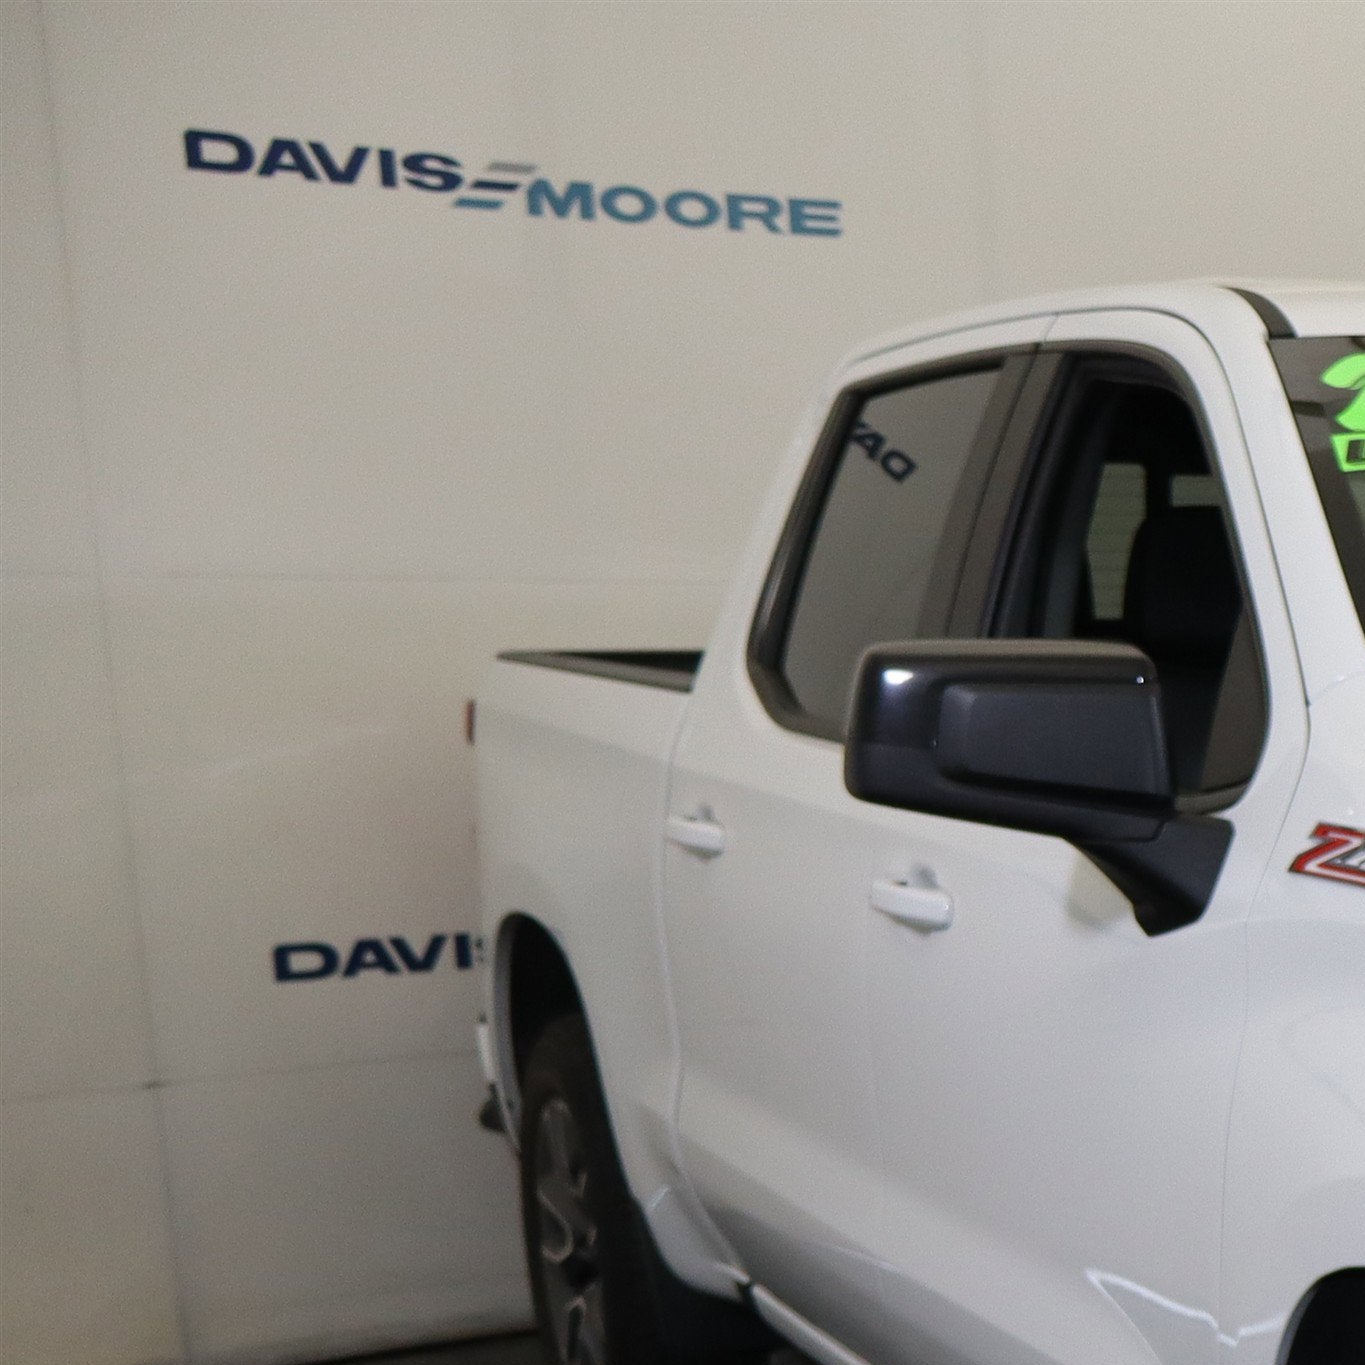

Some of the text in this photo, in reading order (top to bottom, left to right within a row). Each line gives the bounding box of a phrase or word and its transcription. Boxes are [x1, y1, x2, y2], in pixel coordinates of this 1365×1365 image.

[183, 129, 840, 236] DAVIS MOORE
[273, 933, 482, 982] DAVI
